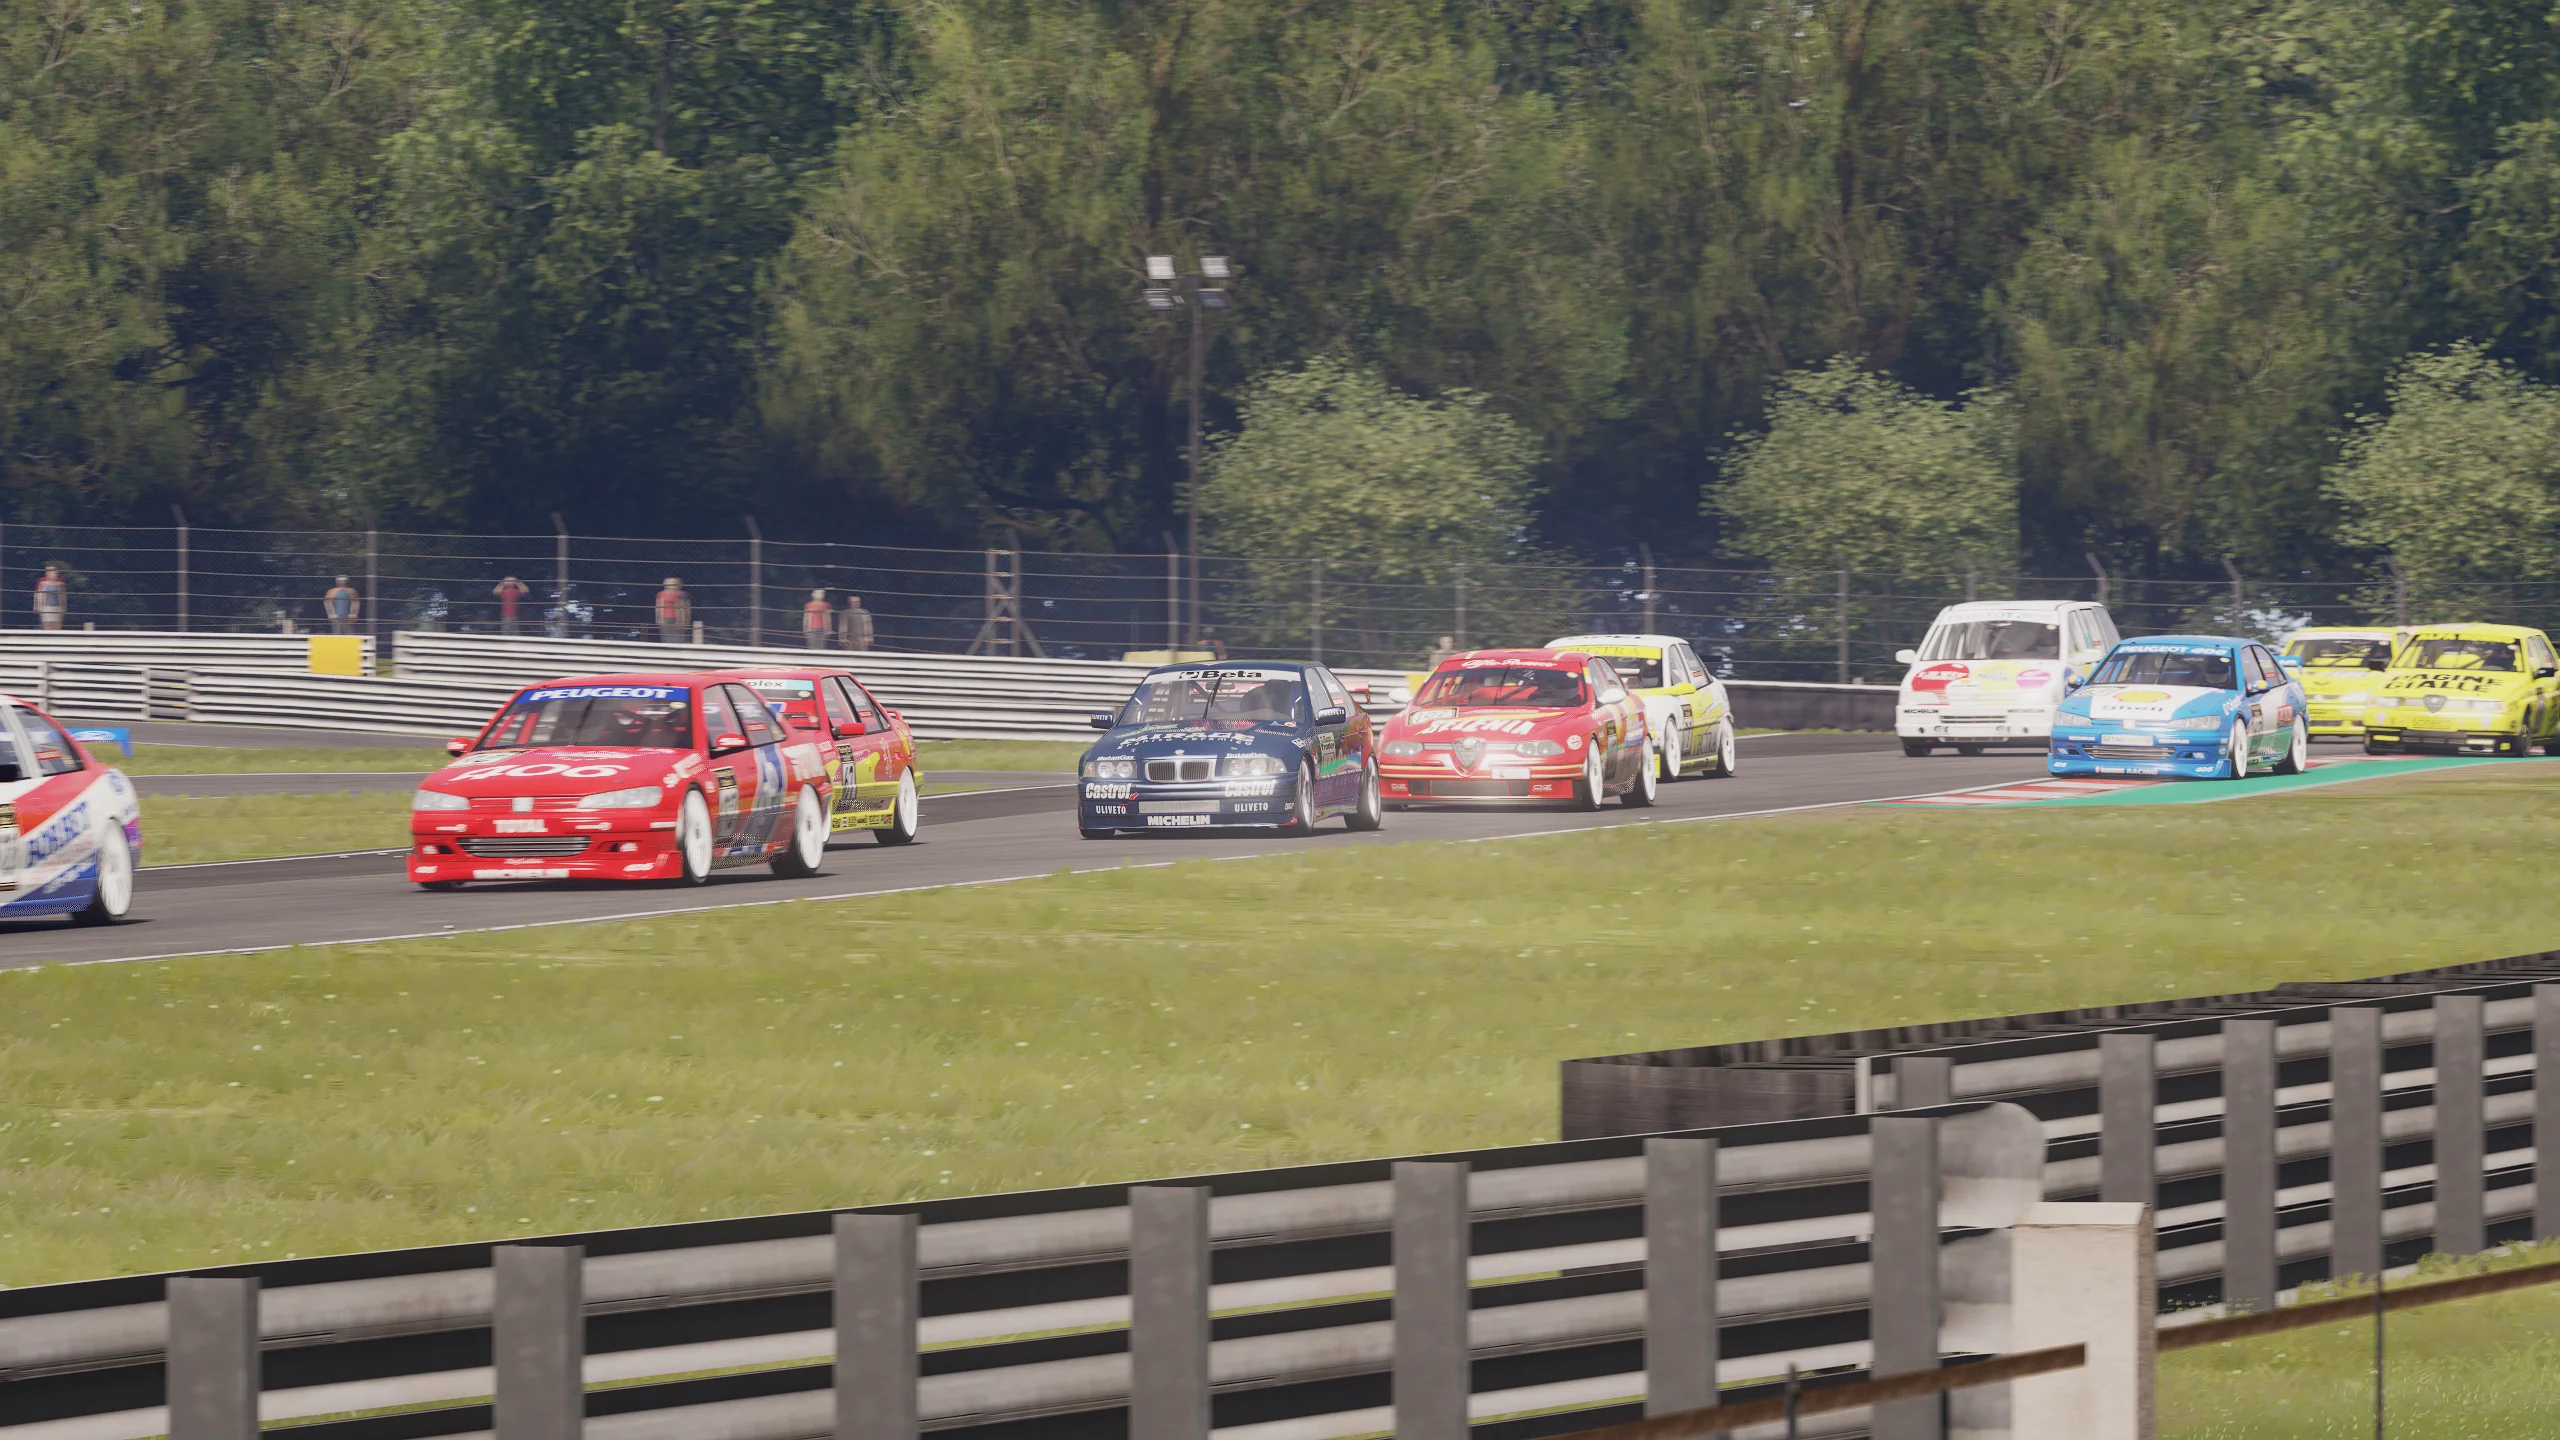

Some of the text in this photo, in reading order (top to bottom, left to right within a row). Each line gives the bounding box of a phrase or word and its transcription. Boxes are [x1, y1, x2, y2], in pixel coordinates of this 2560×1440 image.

[2117, 645, 2229, 655] PEUGEOT 406
[1201, 670, 1263, 680] Beta
[2391, 673, 2503, 687] PAGINE
[2384, 680, 2490, 693] GIALLE
[529, 687, 676, 701] PEUGEOT
[2101, 704, 2165, 713] Shell
[1423, 718, 1537, 736] SELENIA
[447, 763, 631, 782] 406
[1085, 782, 1132, 800] Castrol
[1224, 779, 1277, 797] Castrol
[1095, 805, 1127, 815] ULIVETO
[1234, 802, 1269, 813] ULIVETO
[1147, 815, 1211, 826] MICHELIN
